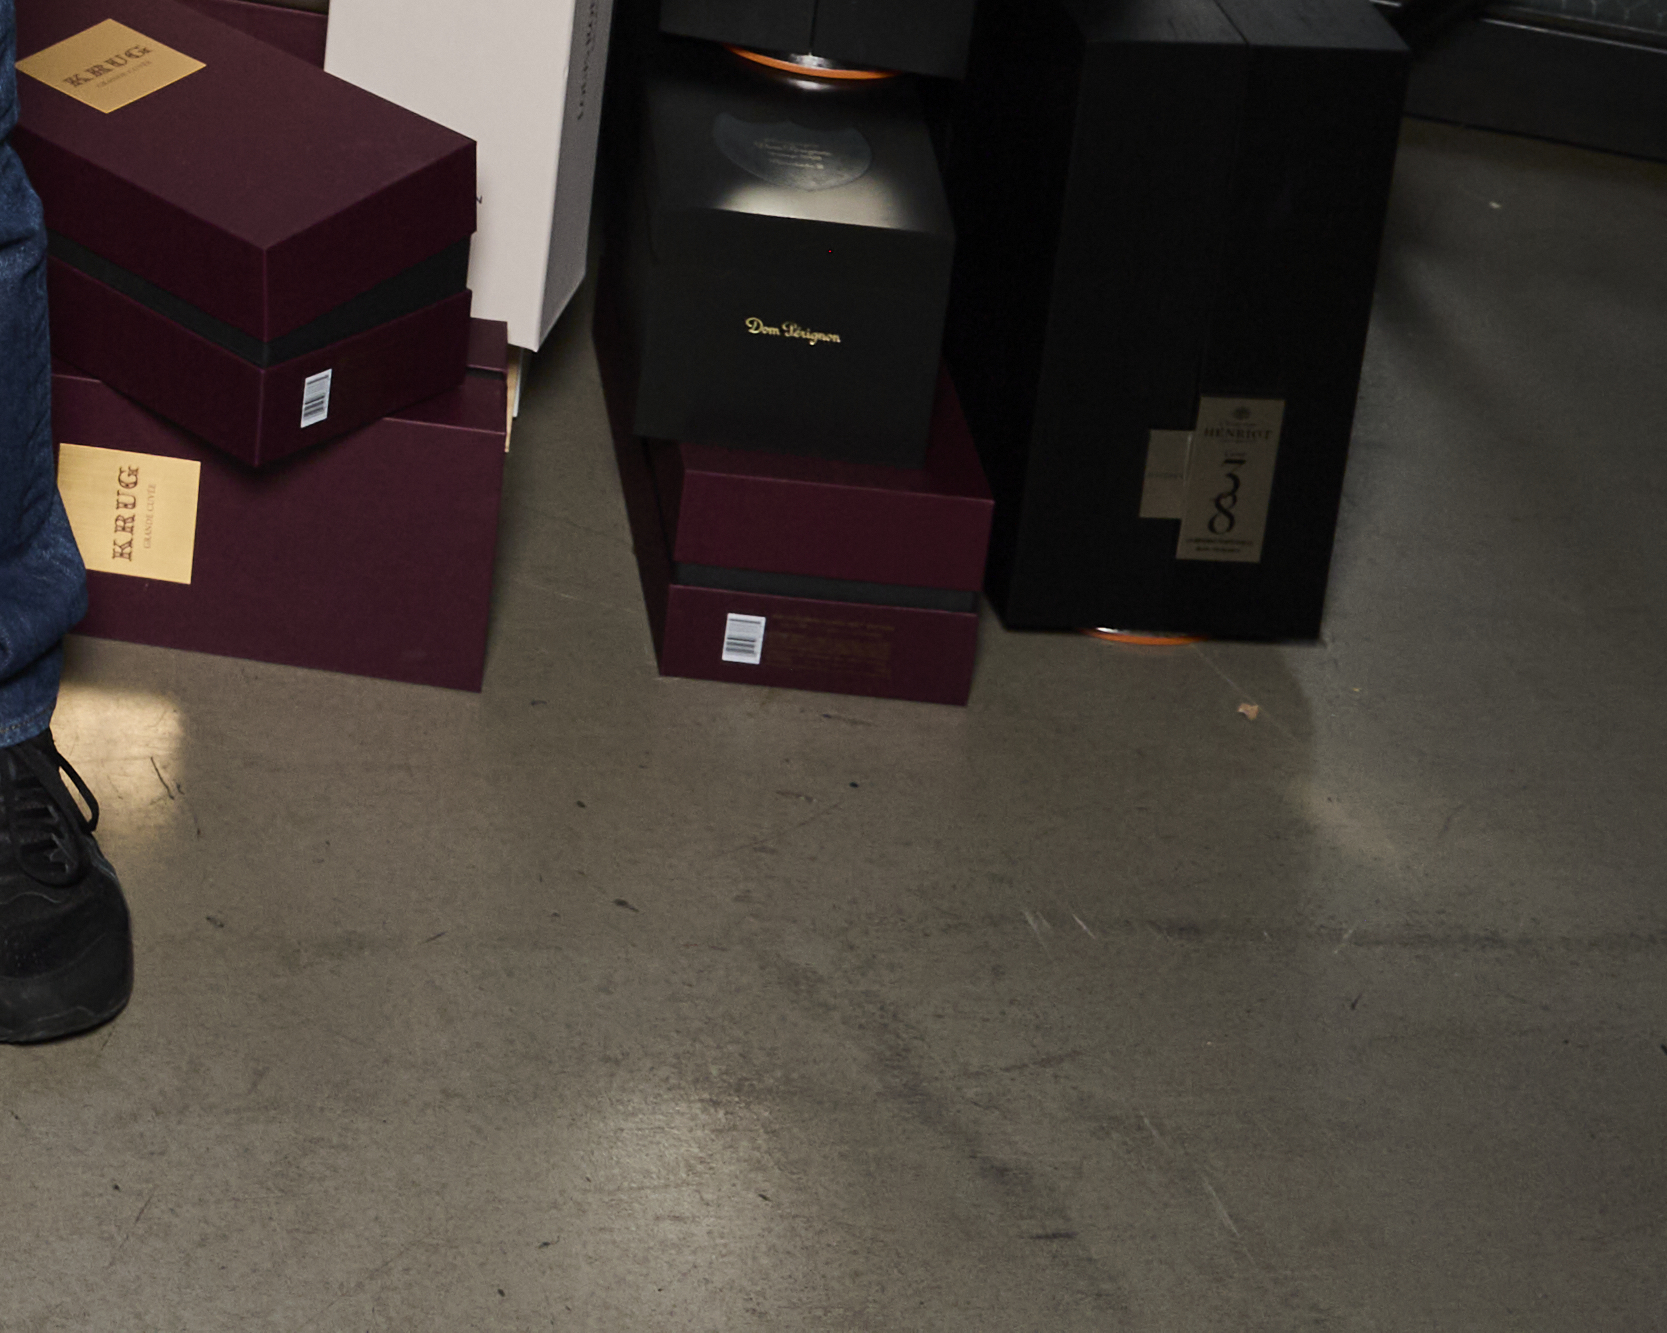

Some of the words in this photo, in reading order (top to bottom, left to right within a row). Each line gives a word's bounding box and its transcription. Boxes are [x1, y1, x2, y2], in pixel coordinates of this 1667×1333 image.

[63, 44, 153, 88] KRUG
[745, 317, 781, 336] Dom
[112, 464, 140, 562] KRUG
